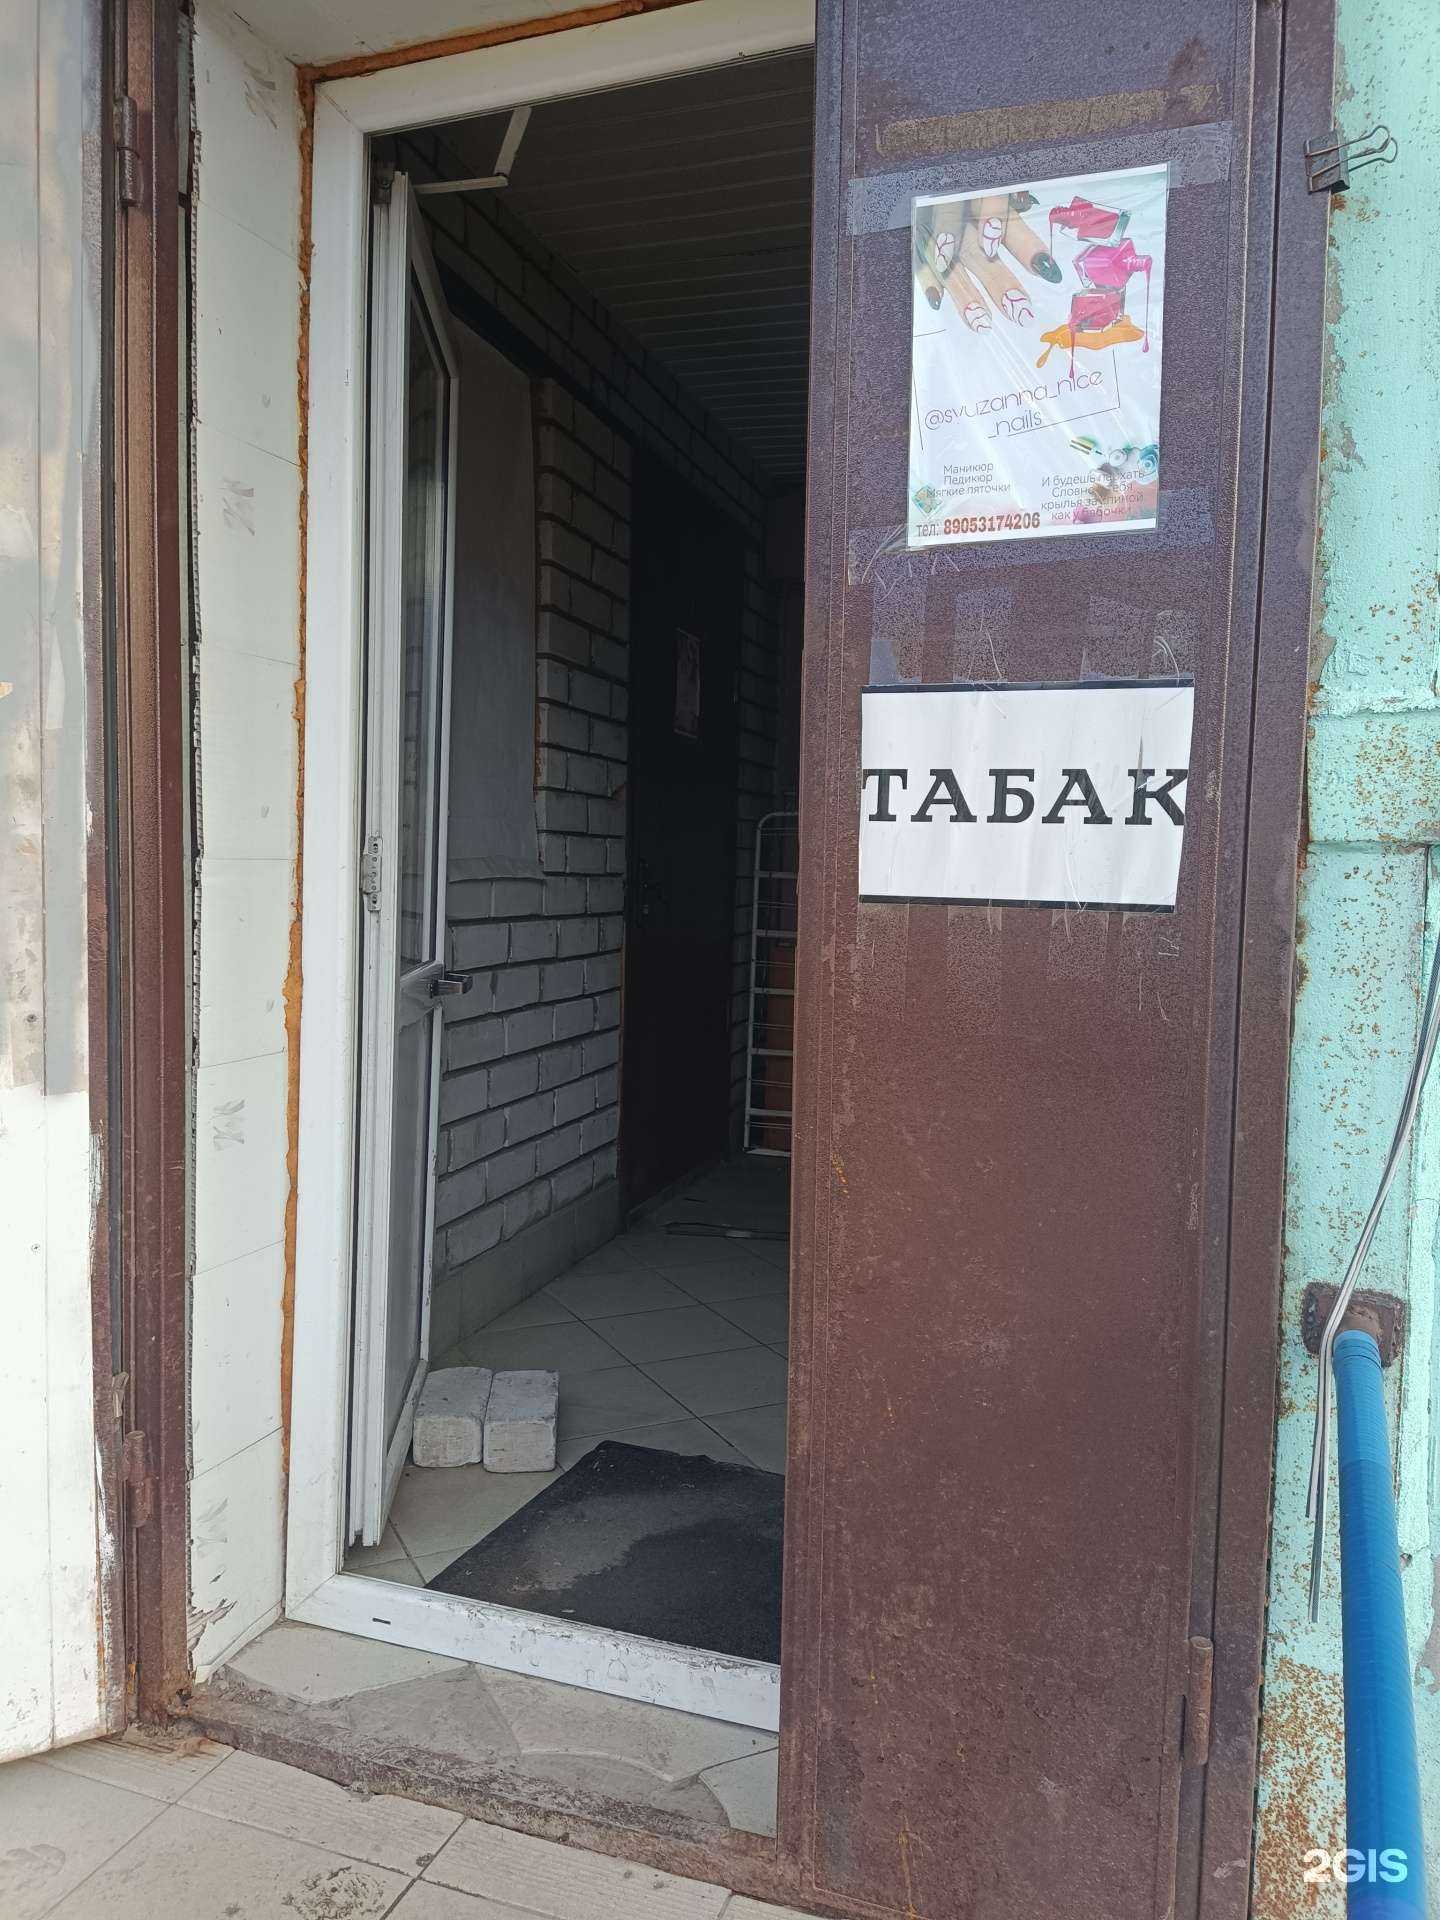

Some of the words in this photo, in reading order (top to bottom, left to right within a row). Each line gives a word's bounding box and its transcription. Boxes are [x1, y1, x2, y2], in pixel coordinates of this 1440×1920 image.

[943, 463, 994, 475] Маникюр
[944, 474, 993, 486] Педикюр
[927, 487, 965, 498] Мягкие
[967, 484, 1011, 496] пяточки
[1041, 498, 1082, 511] крылья
[1051, 511, 1071, 520] как
[943, 512, 1040, 535] 89053174206
[862, 768, 1189, 826] ТАБАК
